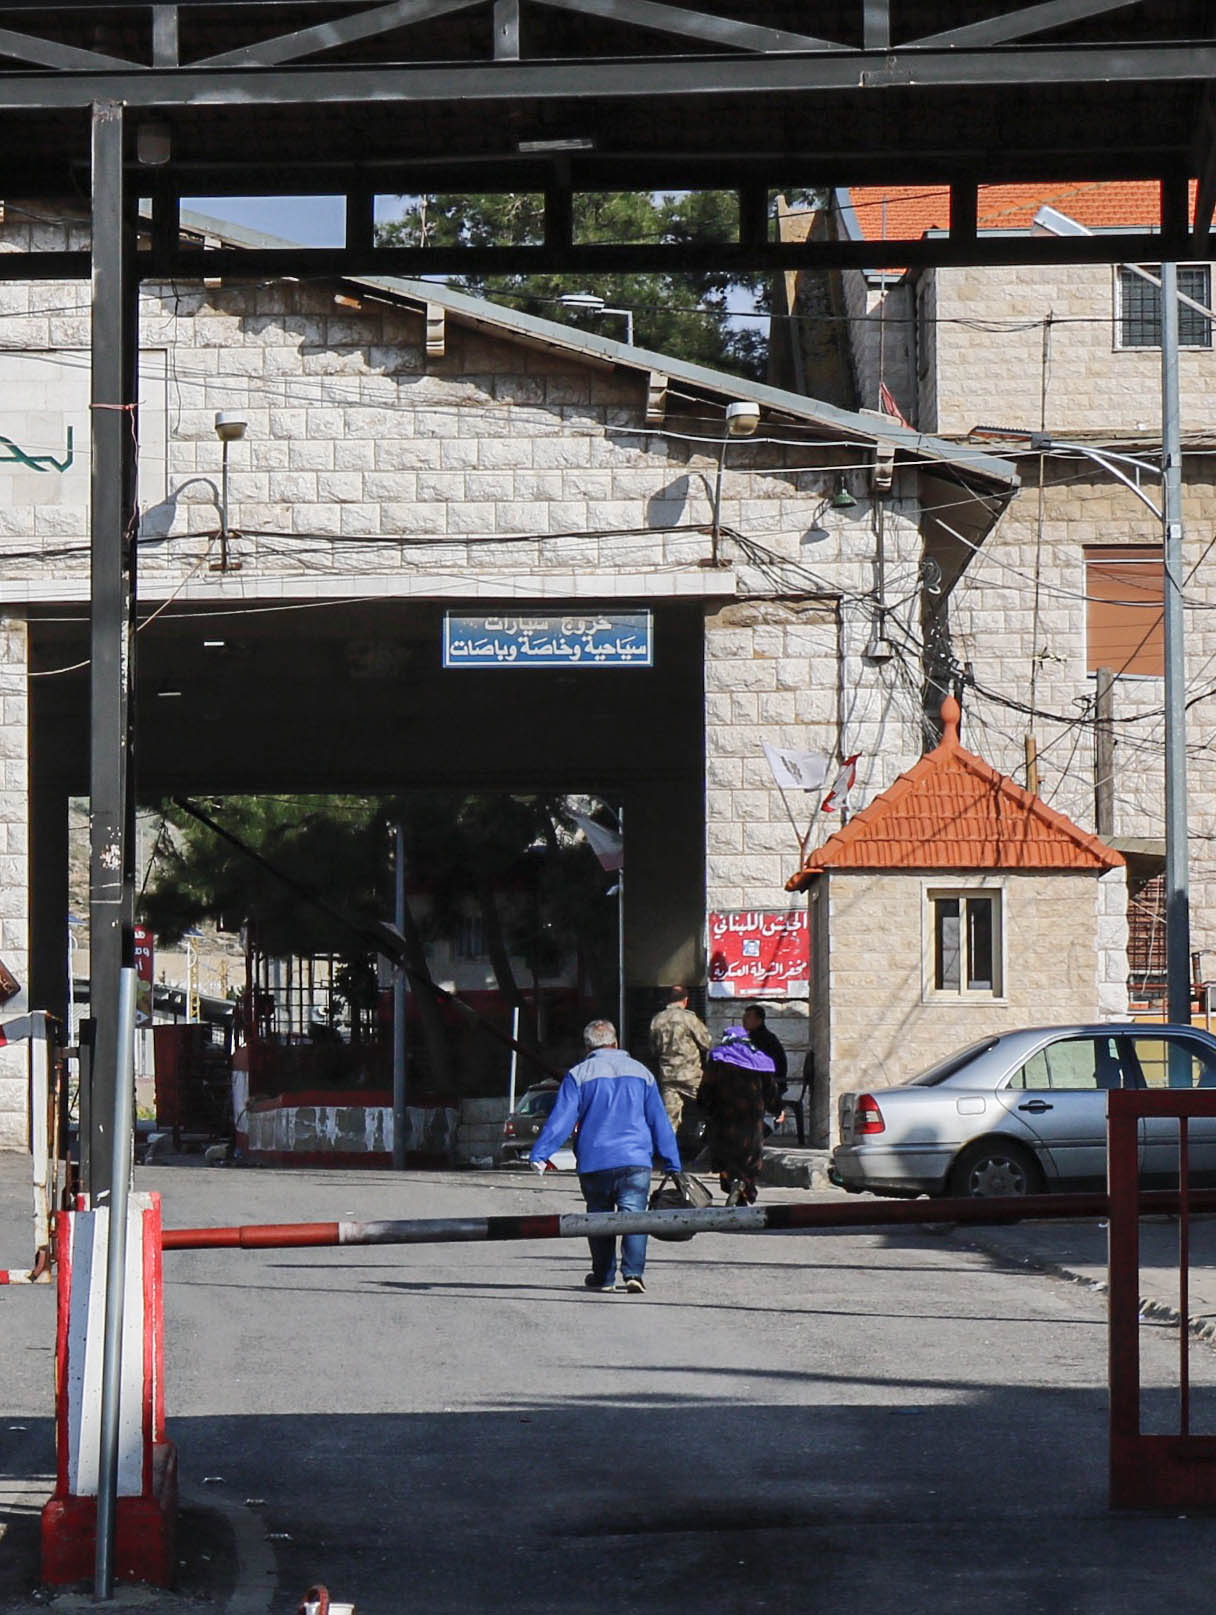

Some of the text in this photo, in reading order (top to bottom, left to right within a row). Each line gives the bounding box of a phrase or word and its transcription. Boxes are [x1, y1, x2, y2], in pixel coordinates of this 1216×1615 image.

[561, 616, 612, 635] خروج
[714, 911, 808, 939] الجيش اللبناني
[750, 960, 784, 980] الشرطة
[778, 960, 808, 980] مخفر
